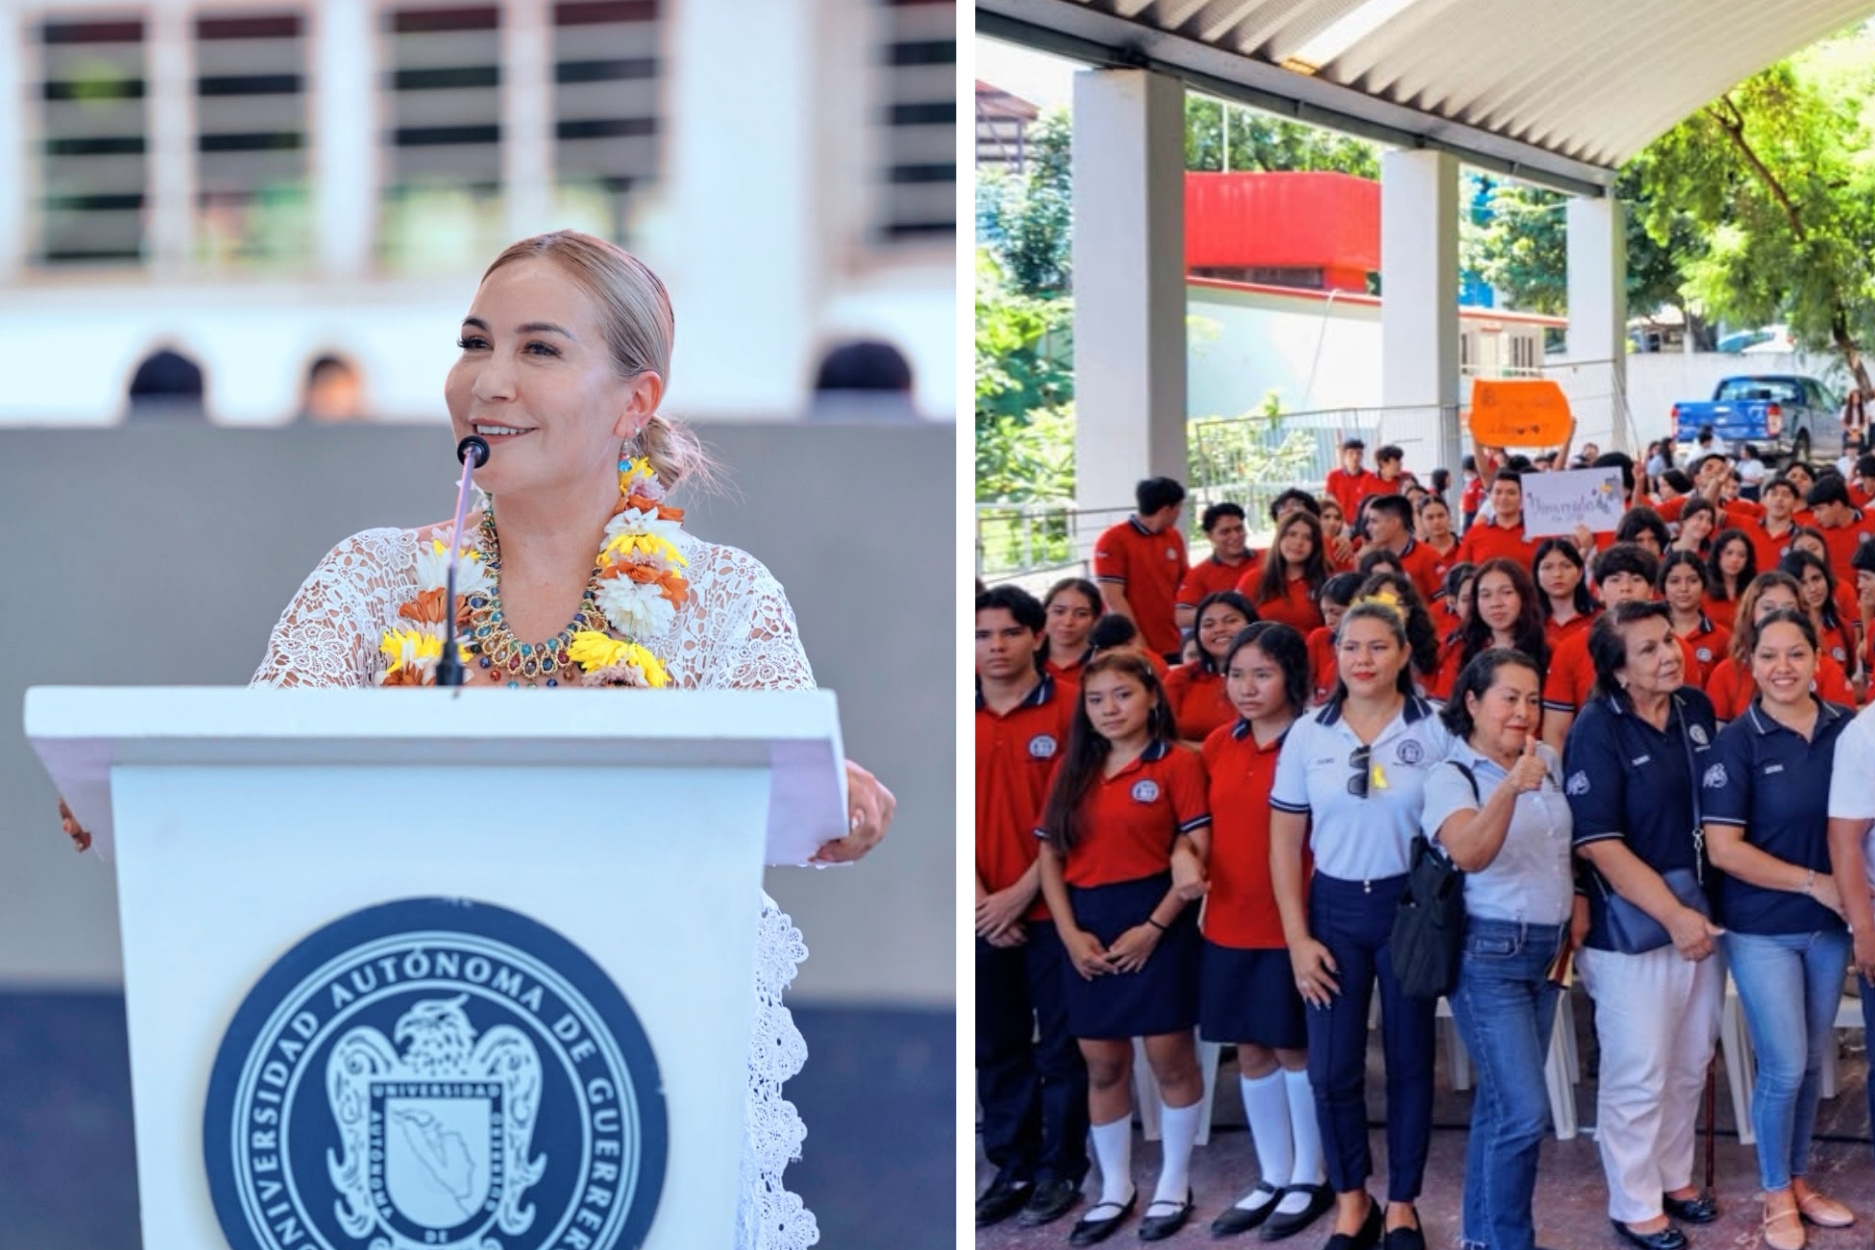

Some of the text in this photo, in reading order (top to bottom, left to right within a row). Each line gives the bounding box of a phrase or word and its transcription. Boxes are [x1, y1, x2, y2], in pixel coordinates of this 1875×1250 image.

[329, 946, 544, 1013] AUTÓNOMA
[552, 1012, 596, 1063] DE
[371, 1084, 501, 1098] UNIVERSIDAD
